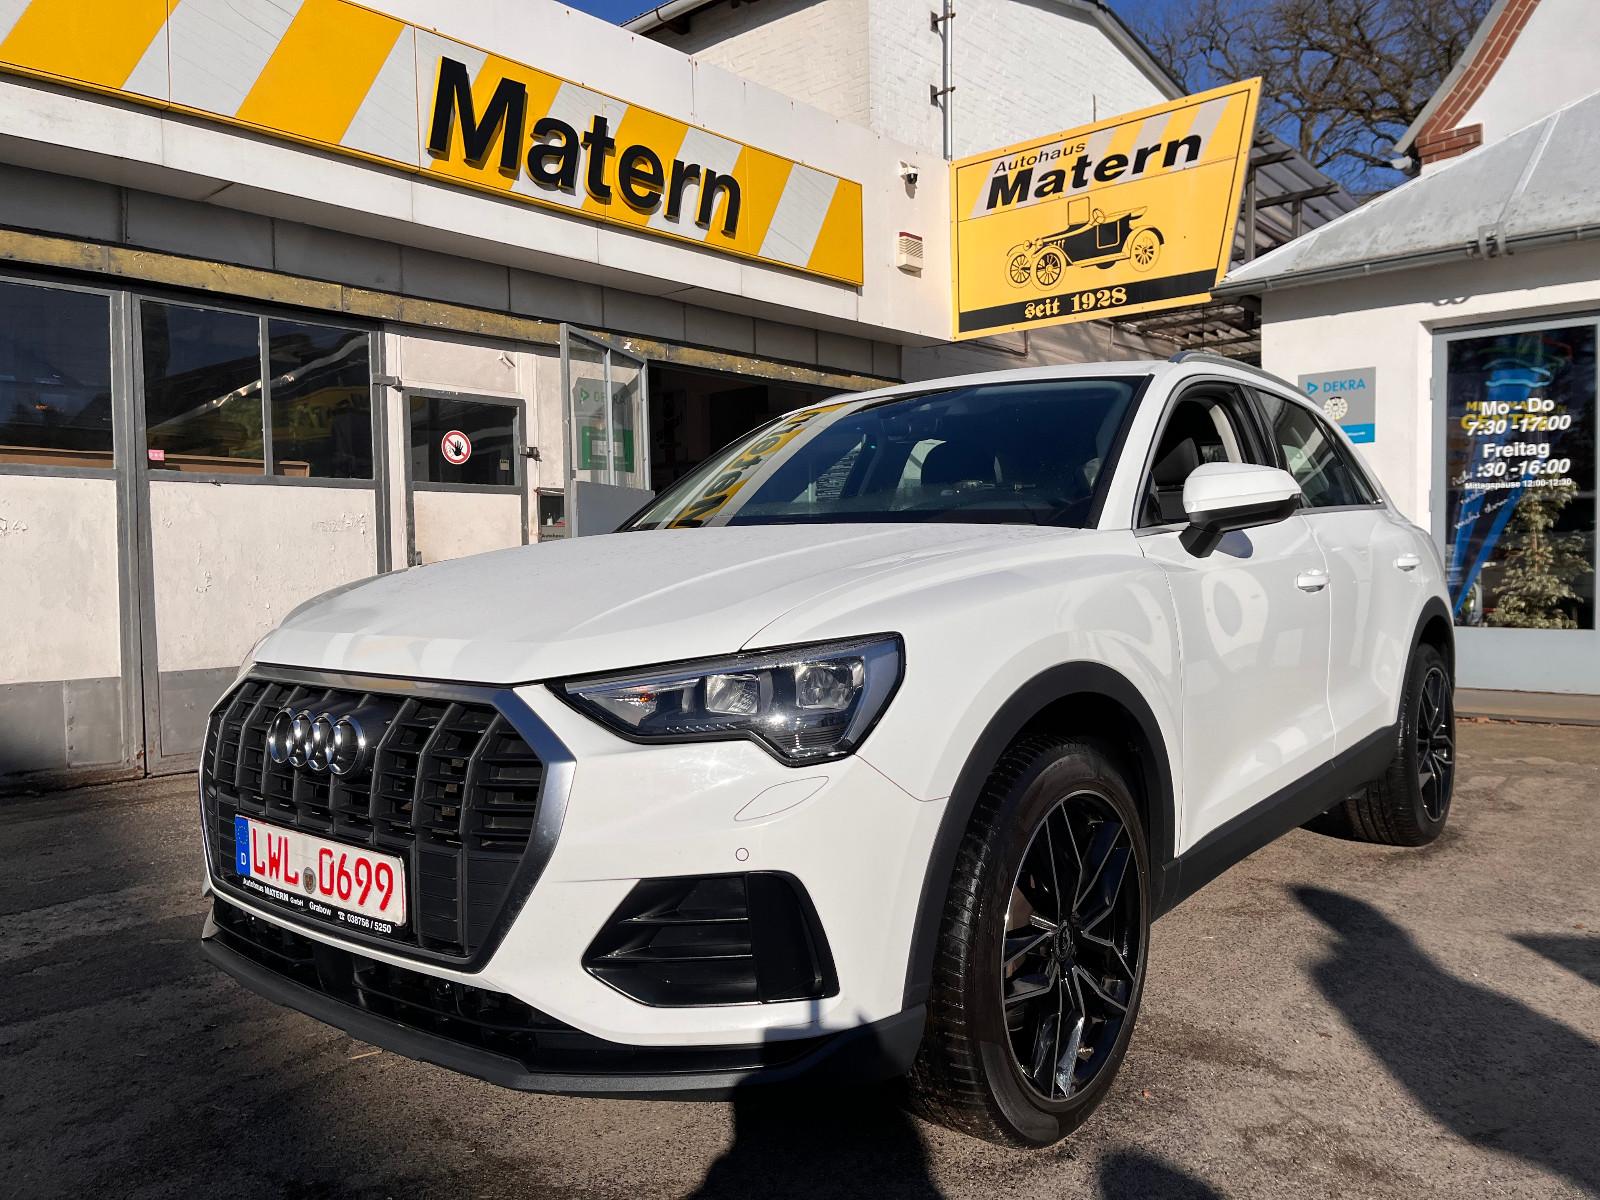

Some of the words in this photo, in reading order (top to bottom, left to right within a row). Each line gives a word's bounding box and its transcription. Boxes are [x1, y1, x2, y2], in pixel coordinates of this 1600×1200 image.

[427, 56, 741, 237] Matern
[995, 142, 1086, 174] Autohaus
[986, 134, 1202, 210] Matern
[1025, 299, 1061, 319] seit
[1071, 287, 1127, 313] 1928
[1323, 379, 1366, 392] DEKRA
[1481, 401, 1510, 415] Mo
[1528, 397, 1554, 412] Do
[1467, 420, 1507, 436] 7:30
[1483, 442, 1550, 458] Freitag
[1465, 480, 1520, 490] Mittagspause
[241, 852, 247, 866] D
[252, 828, 299, 885] LWL
[318, 847, 394, 911] 0699
[264, 886, 289, 901] MATERN
[290, 896, 304, 906] GmbH
[309, 901, 332, 916] Grabow
[374, 921, 392, 933] 5250
